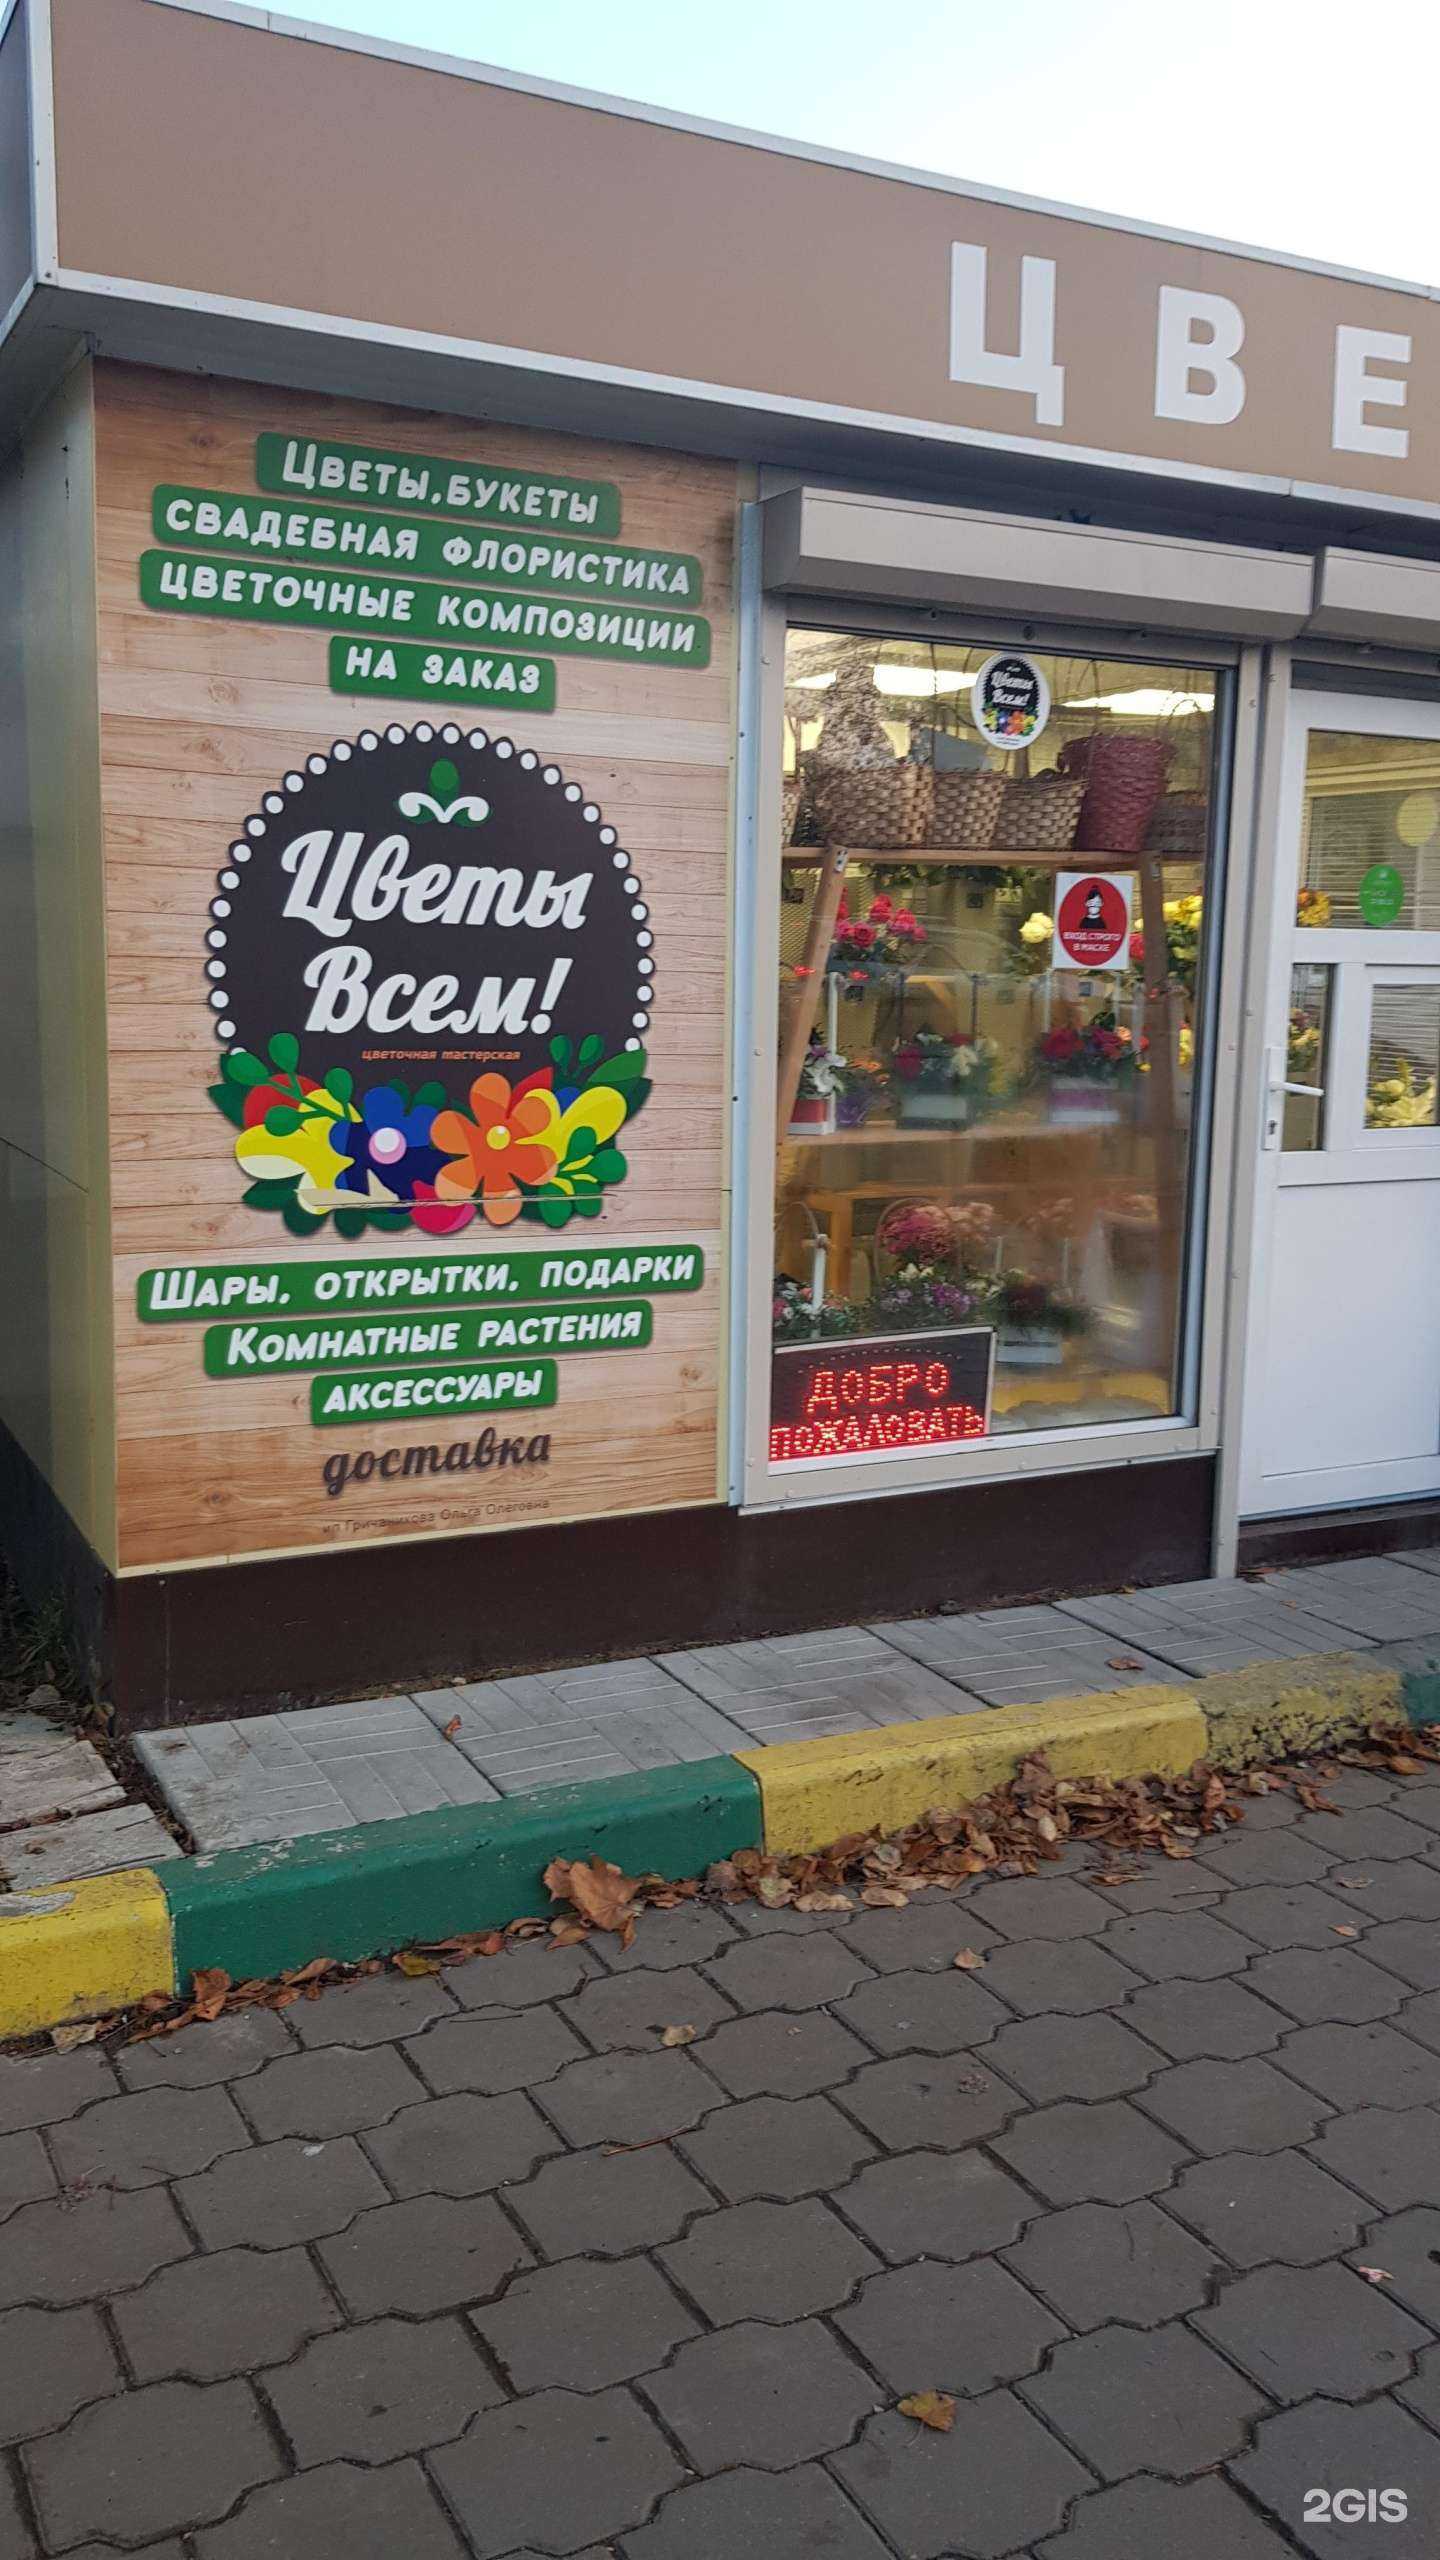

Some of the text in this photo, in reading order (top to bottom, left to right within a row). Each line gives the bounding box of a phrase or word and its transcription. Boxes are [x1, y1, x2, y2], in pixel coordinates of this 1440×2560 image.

[950, 241, 1412, 458] ЦВЕ
[165, 498, 691, 595] СВАДЕБНАЯ ФЛОРИСТИКА
[158, 561, 696, 654] ЦВЕТОЧНЫЕ КОМПОЗИЦИИ
[345, 646, 541, 695] НА ЗАКАЗ
[281, 830, 594, 937] Цветы
[303, 945, 574, 1034] Всем!
[361, 1050, 521, 1062] цветочная мастерская
[315, 1263, 519, 1299] ОТКРЫТКИ,
[541, 1254, 695, 1289] ПОДАРКИ
[226, 1311, 643, 1365] КОМНАТНЫЕ РАСТЕНИЯ
[323, 1369, 543, 1414] АКСЕССУАРЫ
[806, 1361, 949, 1413] ДОБРО
[771, 1405, 984, 1457] ПОЖАЛОВАТЬ
[322, 1427, 552, 1495] доставка
